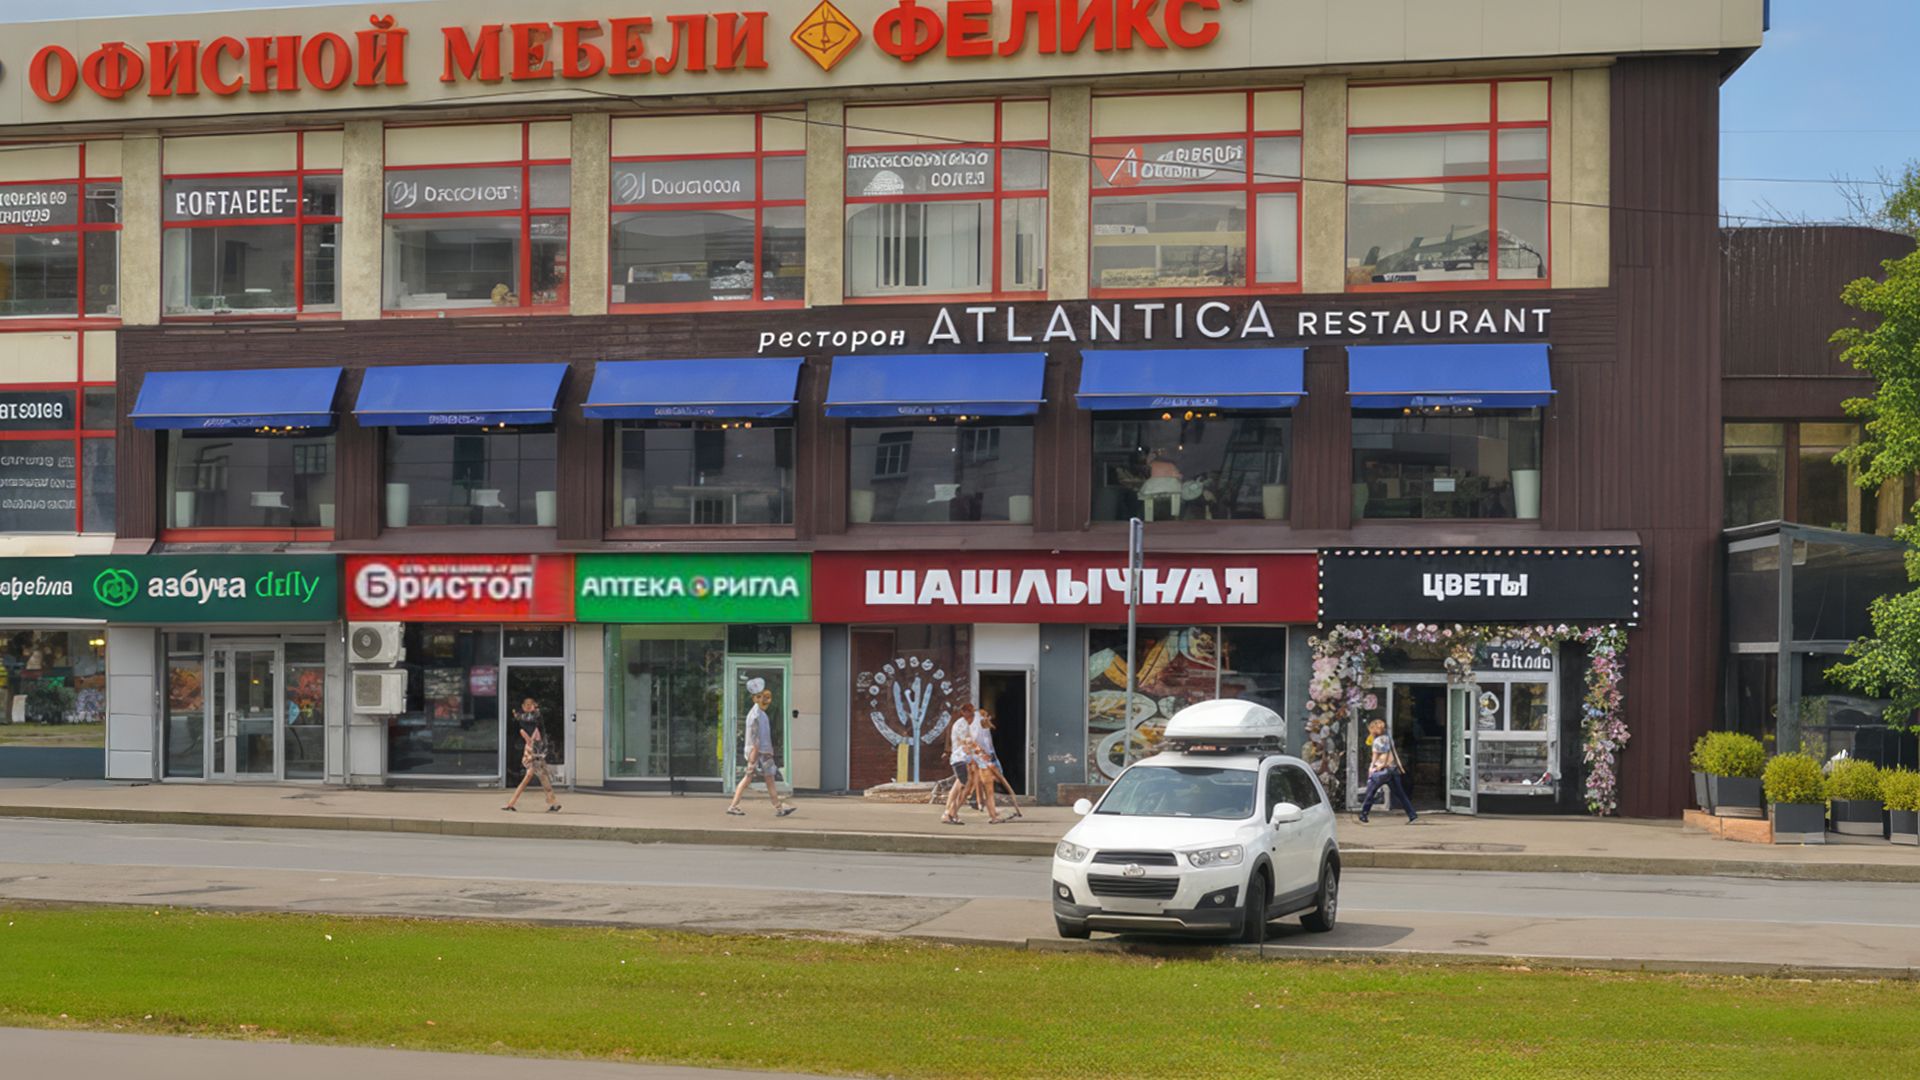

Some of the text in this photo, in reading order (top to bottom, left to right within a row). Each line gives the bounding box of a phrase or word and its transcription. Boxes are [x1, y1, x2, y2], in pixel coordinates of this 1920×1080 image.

[873, 0, 1220, 62] ФЕЛИКС
[28, 11, 769, 103] ОФИСНОЙ МЕБЕЛИ
[928, 300, 1552, 345] ATLANTICA RESTAURANT
[581, 575, 799, 597] АПТЕКА РИГЛА
[865, 567, 1259, 605] ШАШЛЫЧНАЯ
[1422, 573, 1528, 601] ЦВЕТЫ
